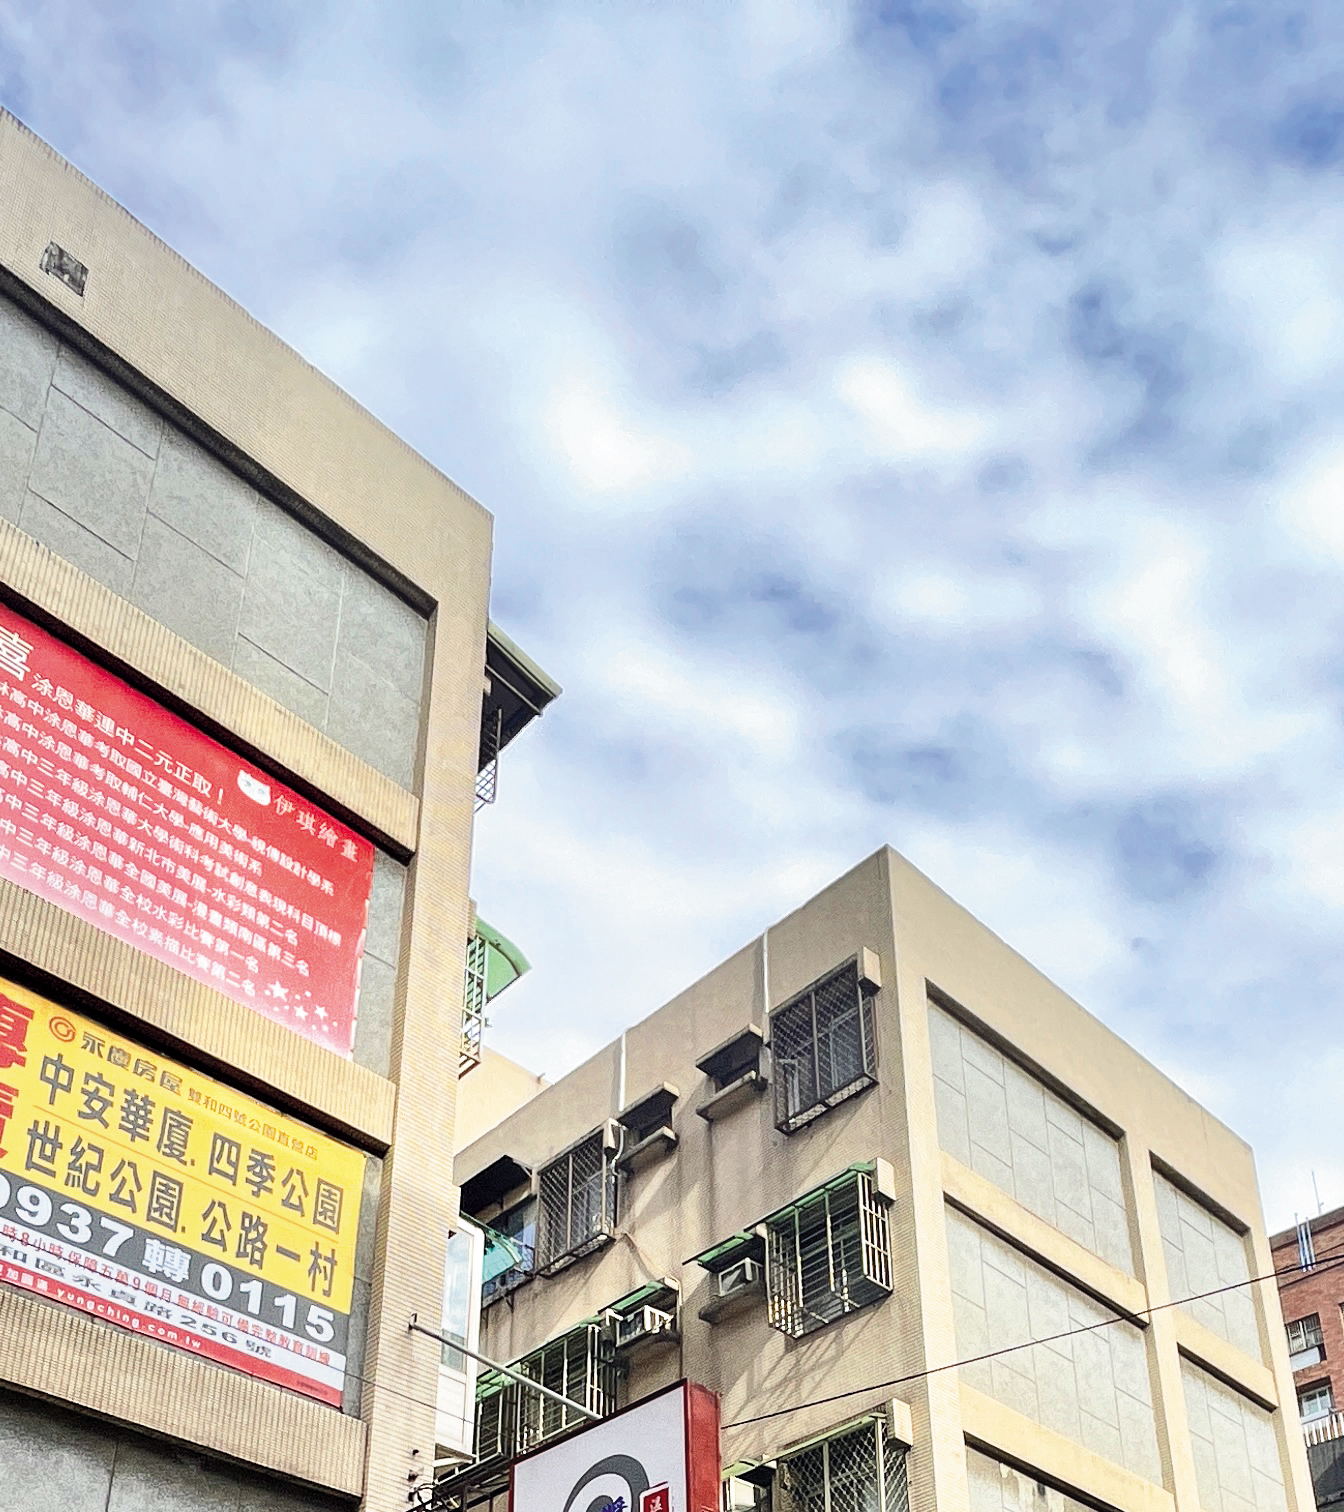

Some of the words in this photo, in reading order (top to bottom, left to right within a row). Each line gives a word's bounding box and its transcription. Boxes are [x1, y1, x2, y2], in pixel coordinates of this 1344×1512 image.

[272, 790, 359, 864] 伊琪繪畫
[80, 1030, 183, 1096] 永慶房屋
[187, 1086, 318, 1162] 雙和四號公園直營店
[207, 1126, 344, 1236] 四季公園
[198, 1191, 338, 1300] 公路一村
[55, 1284, 201, 1352] yungching.com.tw
